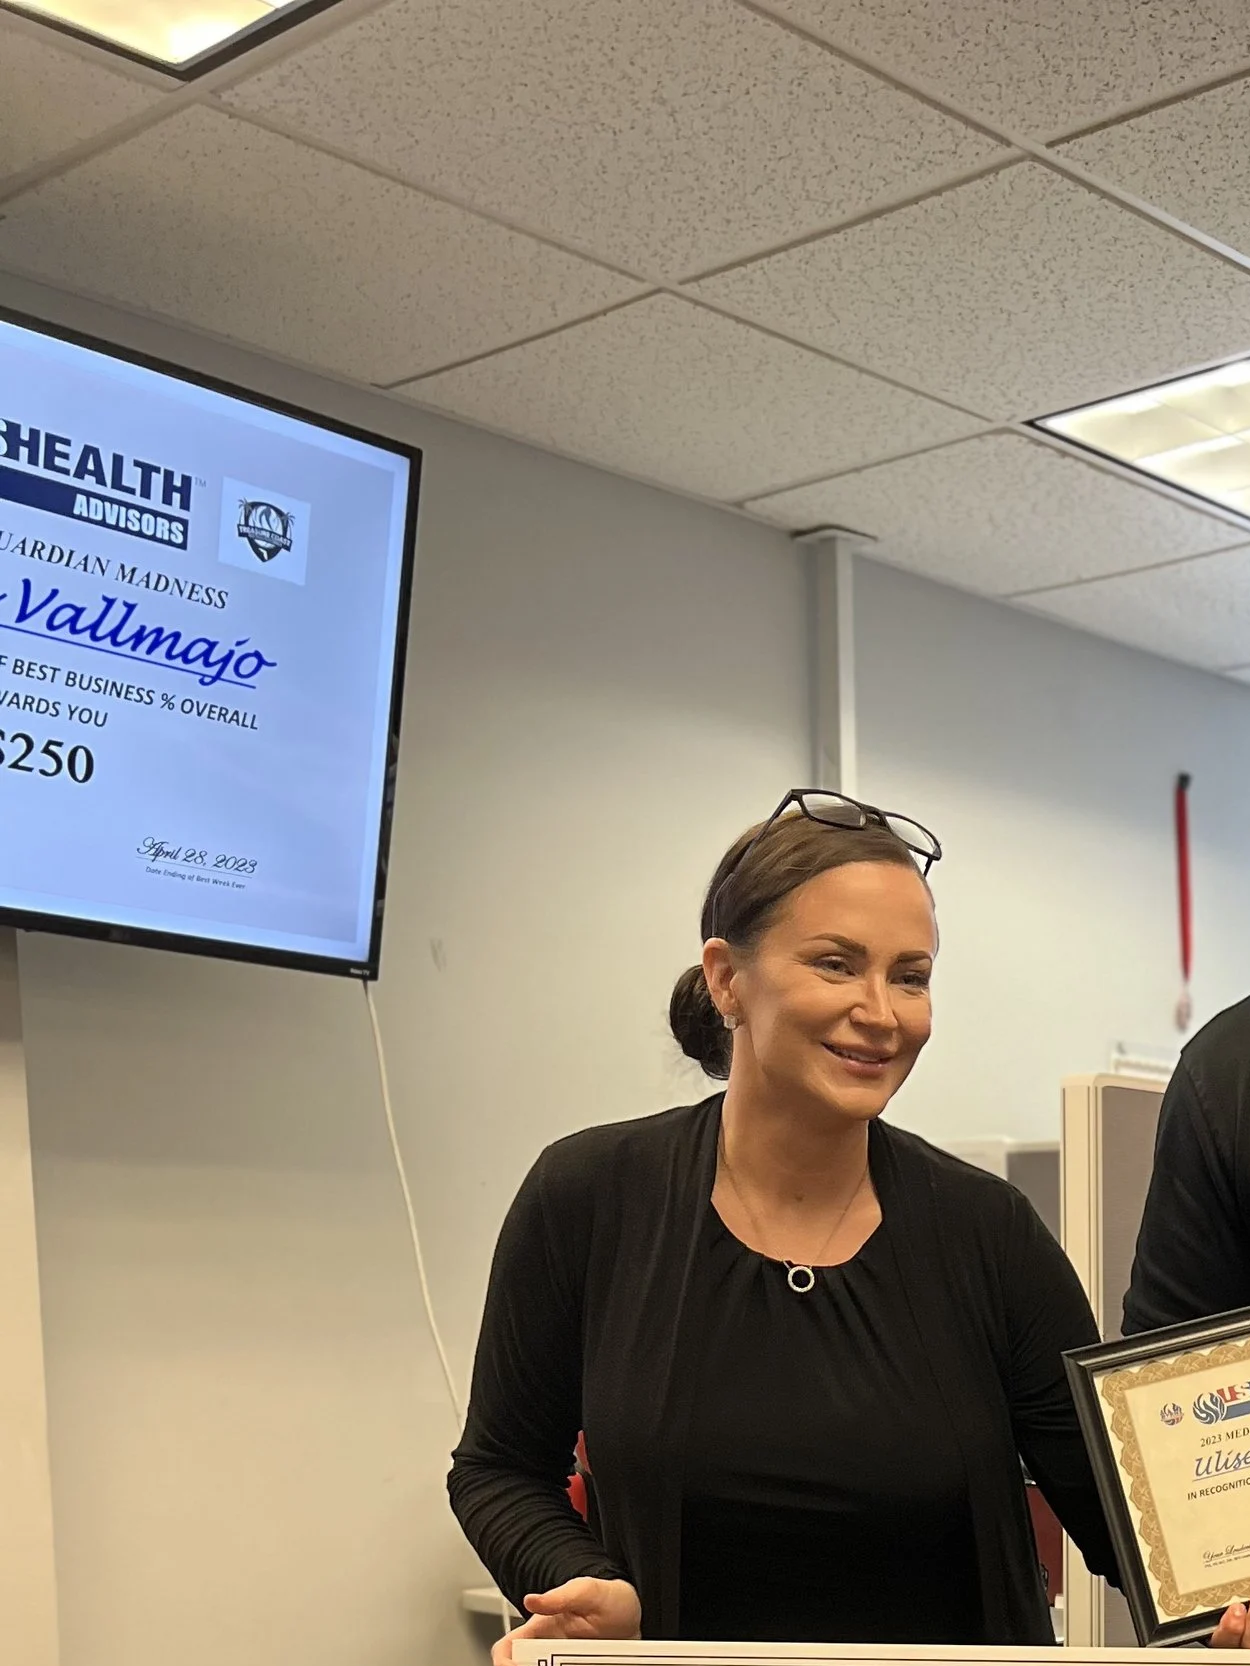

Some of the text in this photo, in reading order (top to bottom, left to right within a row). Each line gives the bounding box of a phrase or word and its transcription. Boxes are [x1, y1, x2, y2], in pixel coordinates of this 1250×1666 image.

[72, 493, 185, 545] ADVISORS
[114, 563, 229, 609] MADNESS
[14, 578, 278, 686] Vallmajo
[12, 658, 61, 683] BEST
[64, 671, 156, 706] BUSINESS
[160, 692, 176, 711] %
[180, 698, 260, 730] OVERALL
[67, 704, 109, 728] YOU
[0, 729, 94, 784] 250
[136, 836, 258, 874] April 28, 2023
[145, 866, 161, 875] Date
[163, 870, 187, 881] Ending
[195, 875, 211, 884] Best
[212, 878, 230, 888] Week
[231, 880, 246, 890] Ever
[1200, 1433, 1222, 1447] 2023
[1187, 1491, 1198, 1500] IN
